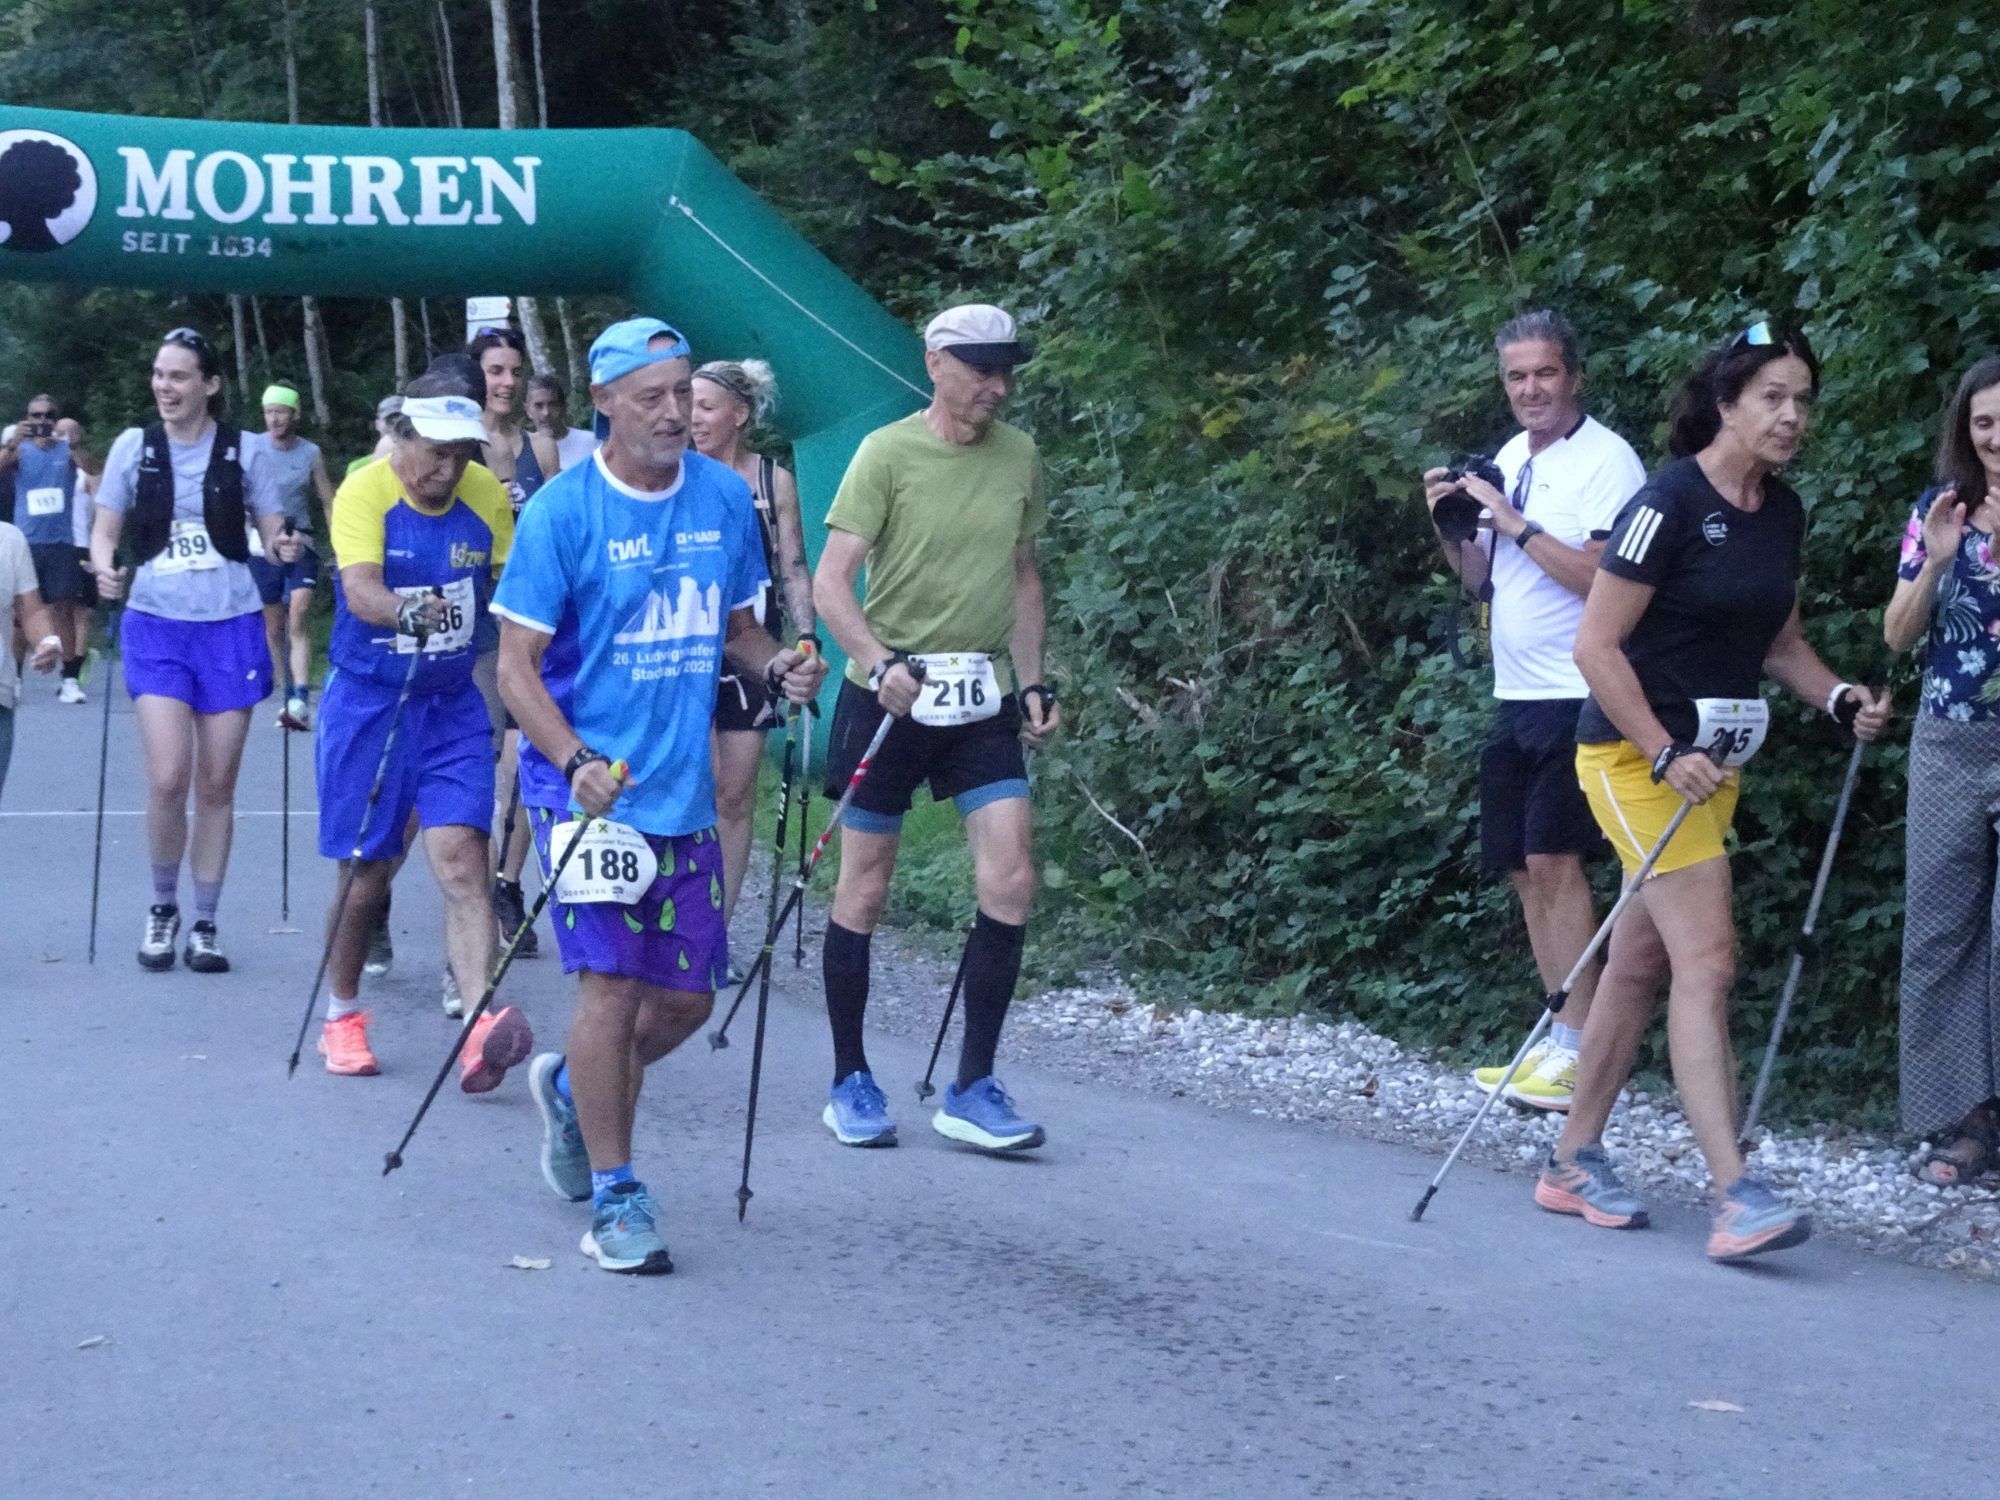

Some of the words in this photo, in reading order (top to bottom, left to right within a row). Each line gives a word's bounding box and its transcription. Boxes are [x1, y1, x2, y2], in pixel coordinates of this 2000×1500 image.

[117, 146, 541, 225] MOHREN
[122, 230, 191, 254] SEIT
[166, 534, 207, 560] 189
[607, 533, 652, 562] twl
[684, 660, 714, 674] 2025
[933, 678, 985, 707] 216
[578, 848, 639, 883] 188
